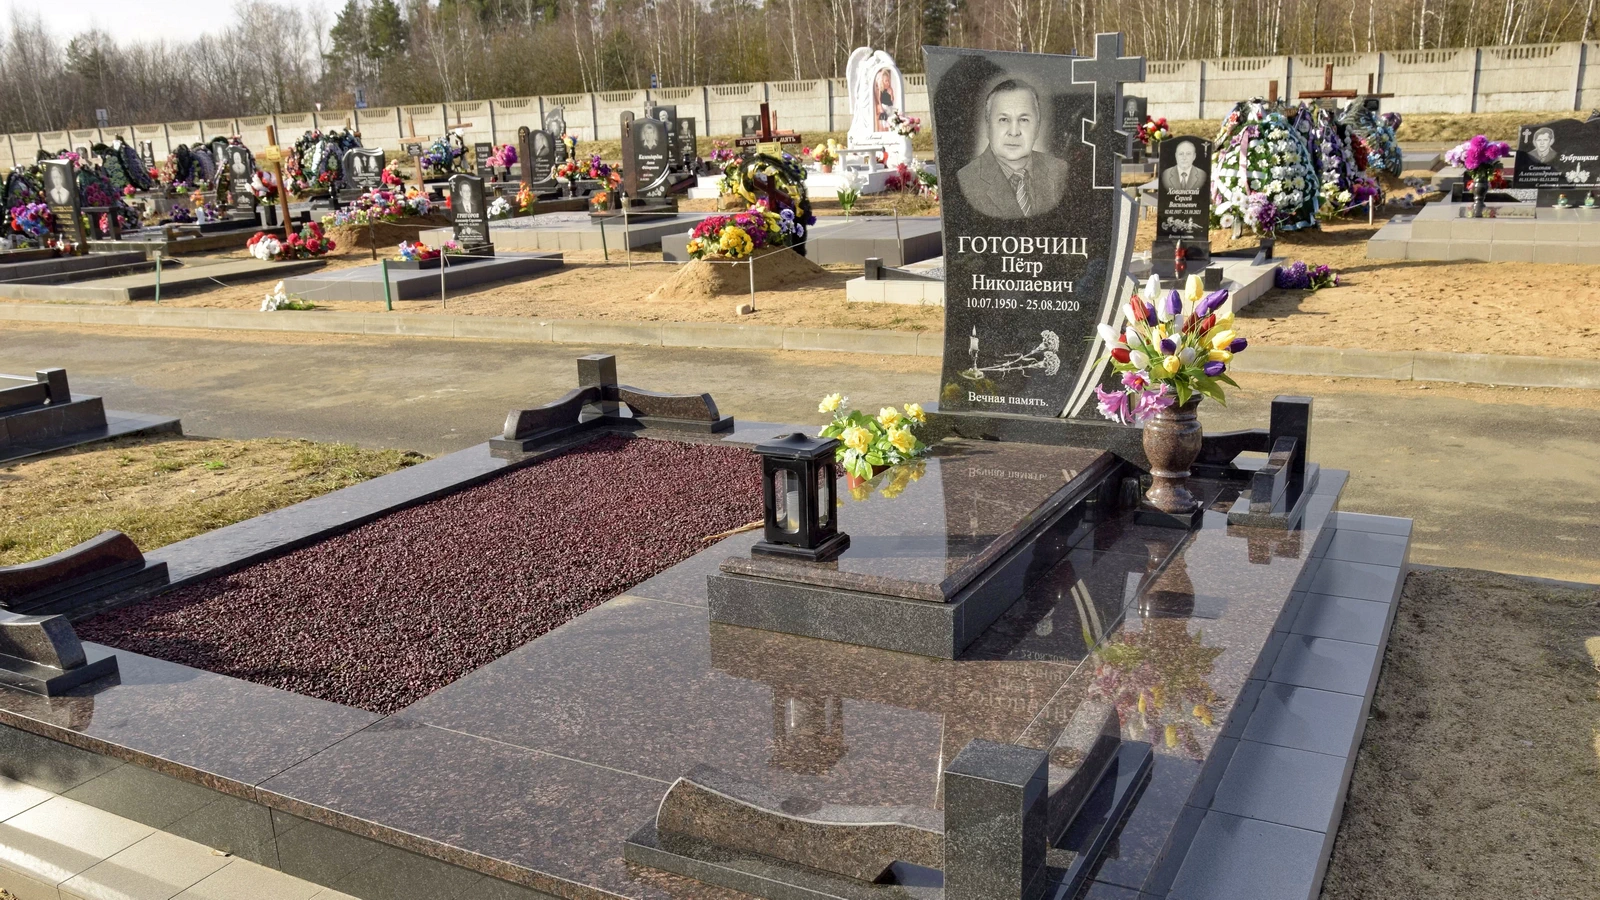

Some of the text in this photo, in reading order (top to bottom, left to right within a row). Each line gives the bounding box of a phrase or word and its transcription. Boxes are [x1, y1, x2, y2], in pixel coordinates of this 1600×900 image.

[1560, 153, 1599, 163] Зубрицкие
[1166, 187, 1200, 196] Хованский
[1174, 195, 1193, 203] Сергей
[958, 236, 1088, 259] ГОТОВЧИЦ
[1001, 256, 1043, 278] Пётр
[971, 274, 1074, 293] Николаевич
[966, 297, 1018, 310] 10.07.1950
[1026, 299, 1080, 312] 25.08.2020
[968, 391, 1049, 407] Вечная память.
